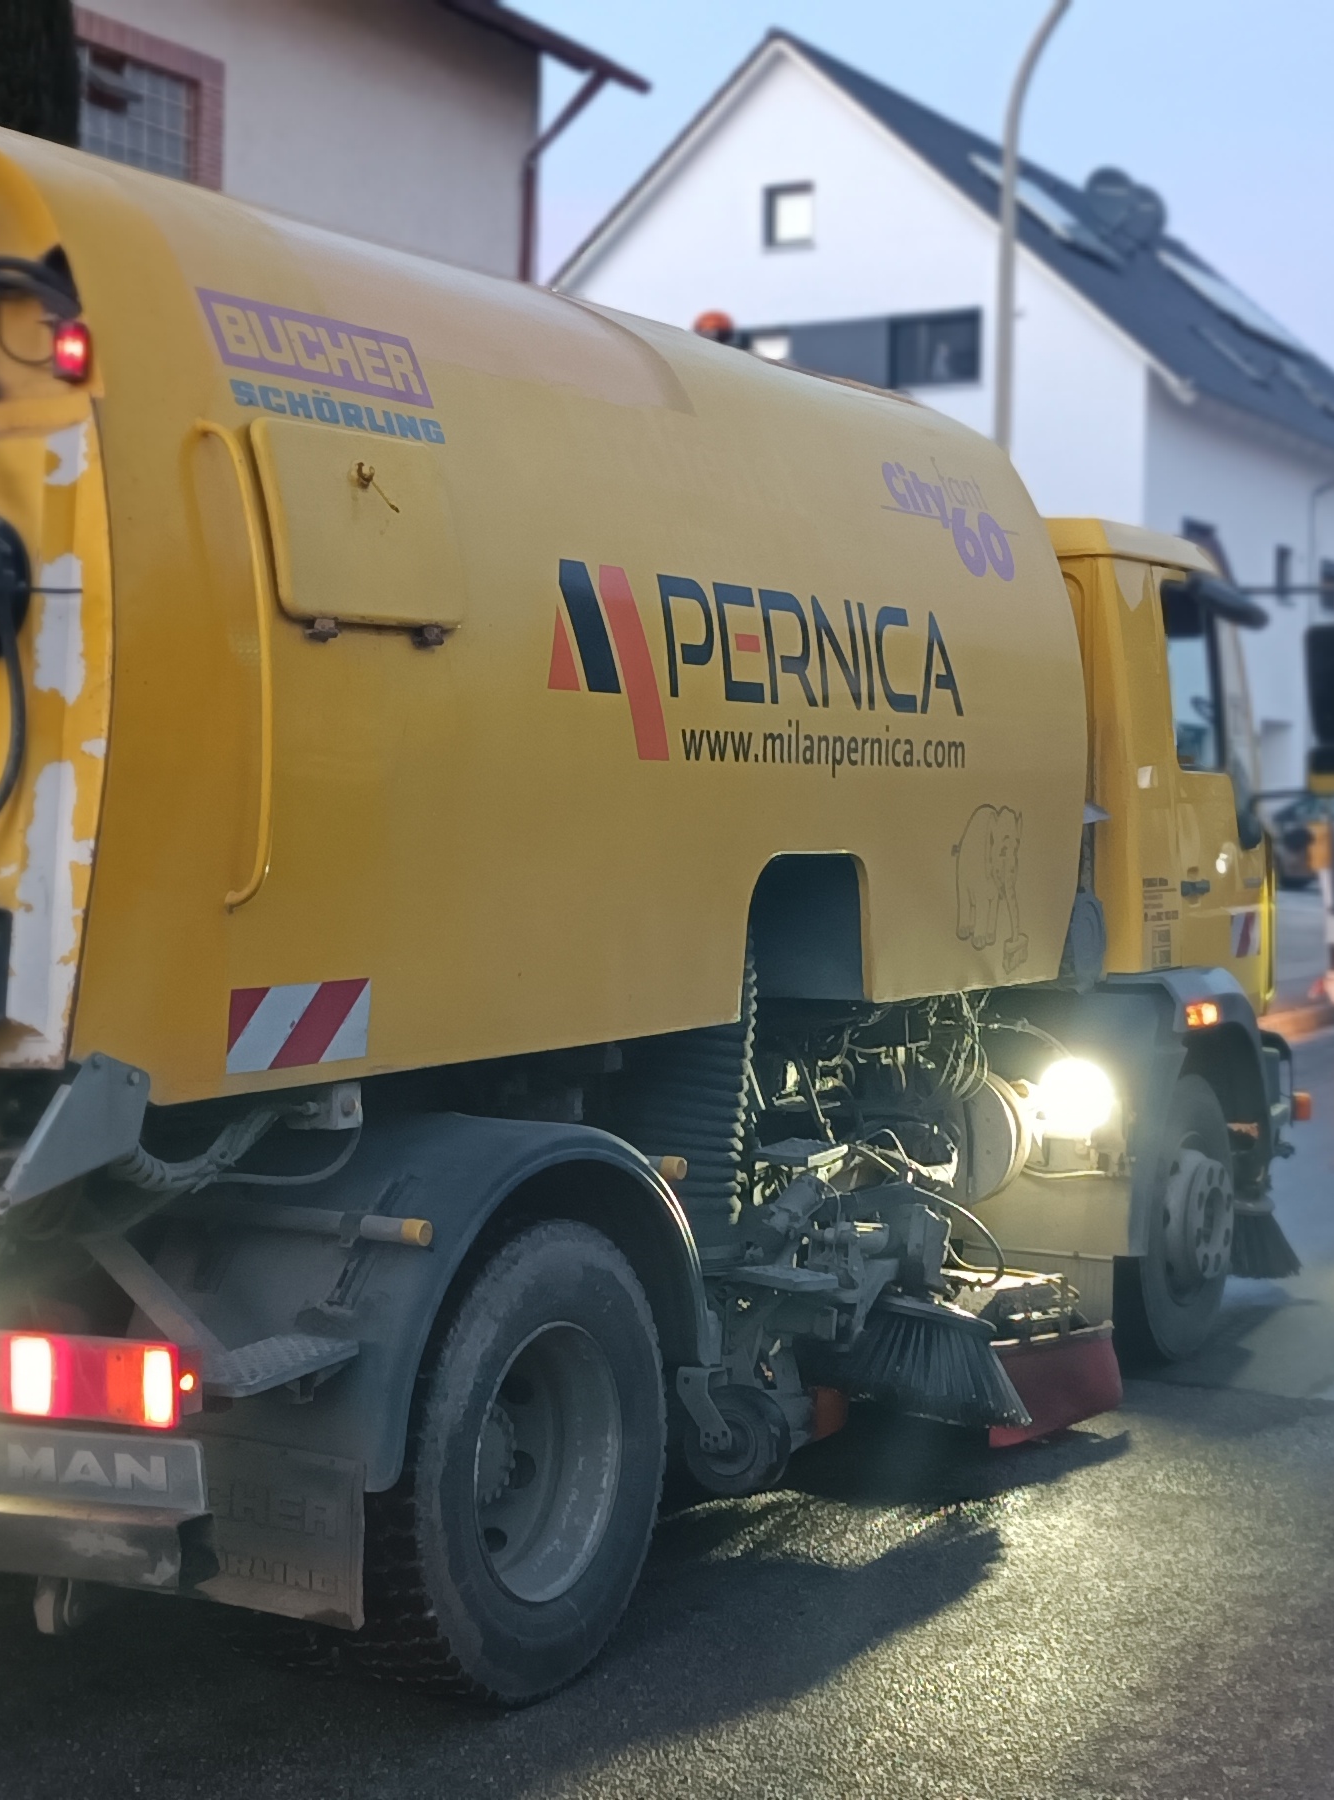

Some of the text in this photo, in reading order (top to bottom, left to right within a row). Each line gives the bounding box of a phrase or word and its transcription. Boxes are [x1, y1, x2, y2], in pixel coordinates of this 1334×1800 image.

[209, 301, 424, 395] BUCHER
[229, 378, 447, 445] SCHÖRLING
[951, 507, 1015, 582] 60
[656, 573, 965, 716] PERNICA
[681, 719, 966, 778] www.milanpernica.com
[7, 1441, 170, 1492] MAN
